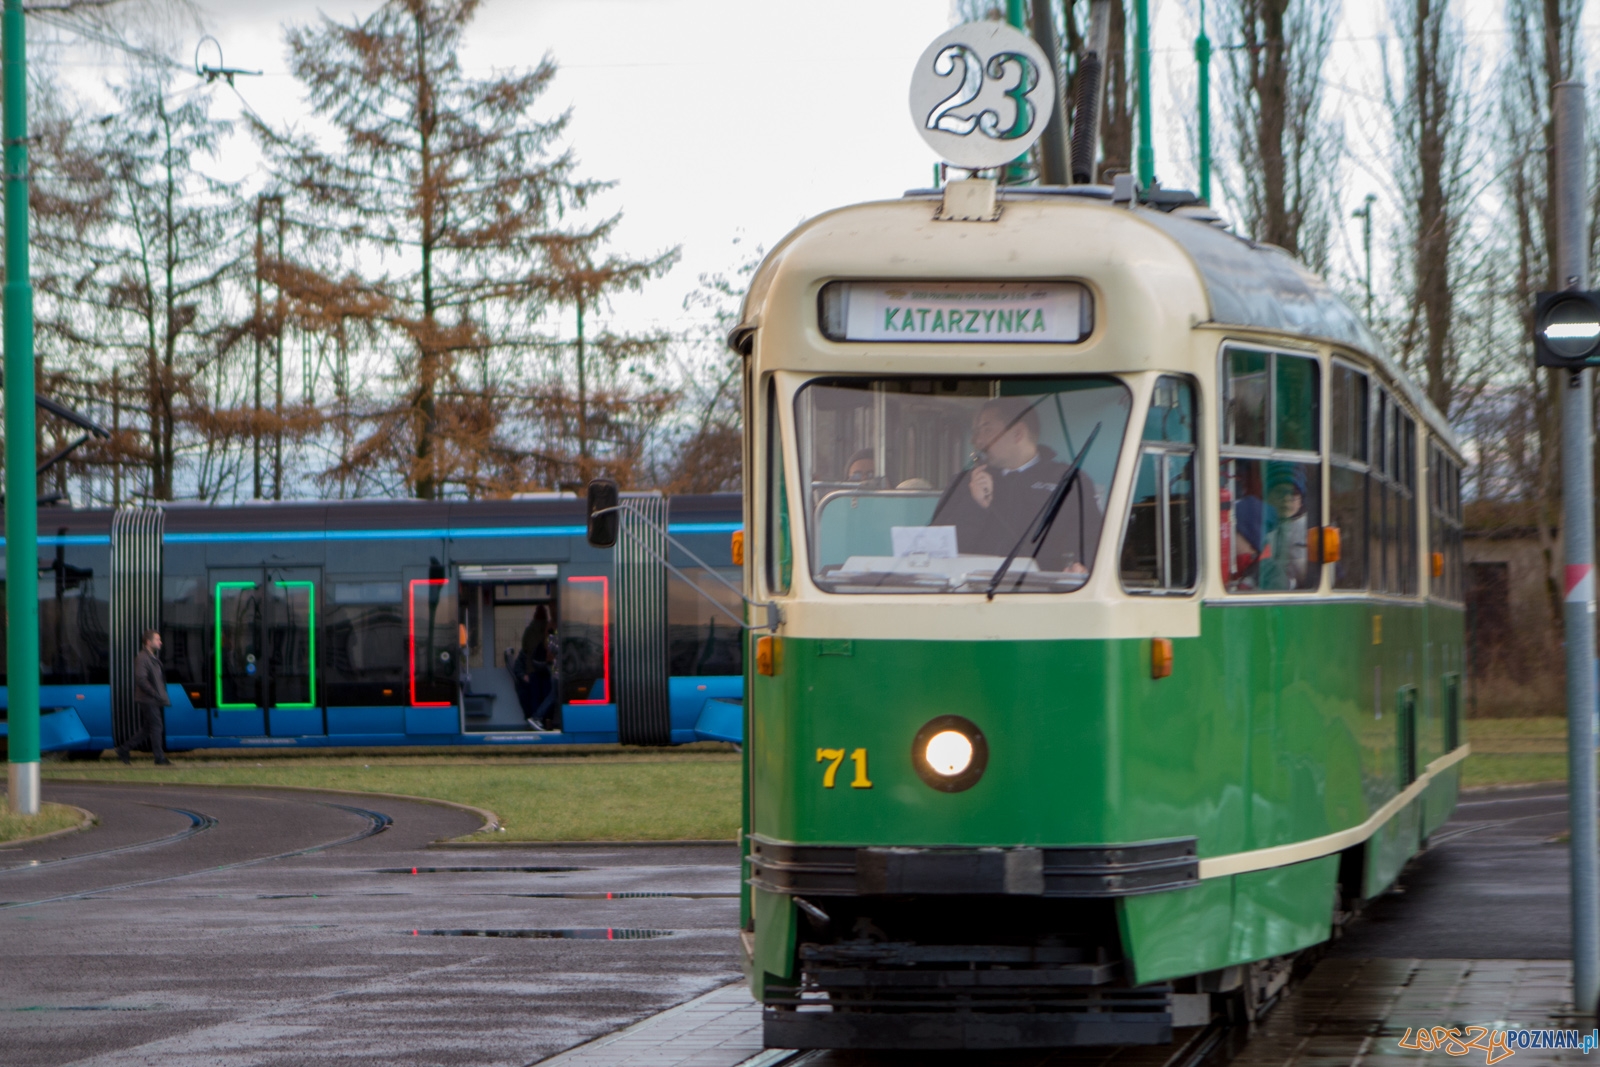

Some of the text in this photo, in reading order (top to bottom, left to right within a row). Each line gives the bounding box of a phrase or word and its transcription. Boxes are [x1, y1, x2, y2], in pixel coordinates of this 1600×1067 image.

[925, 43, 1040, 140] 23
[884, 306, 1047, 333] KATARZYNKA
[815, 747, 873, 789] 71
